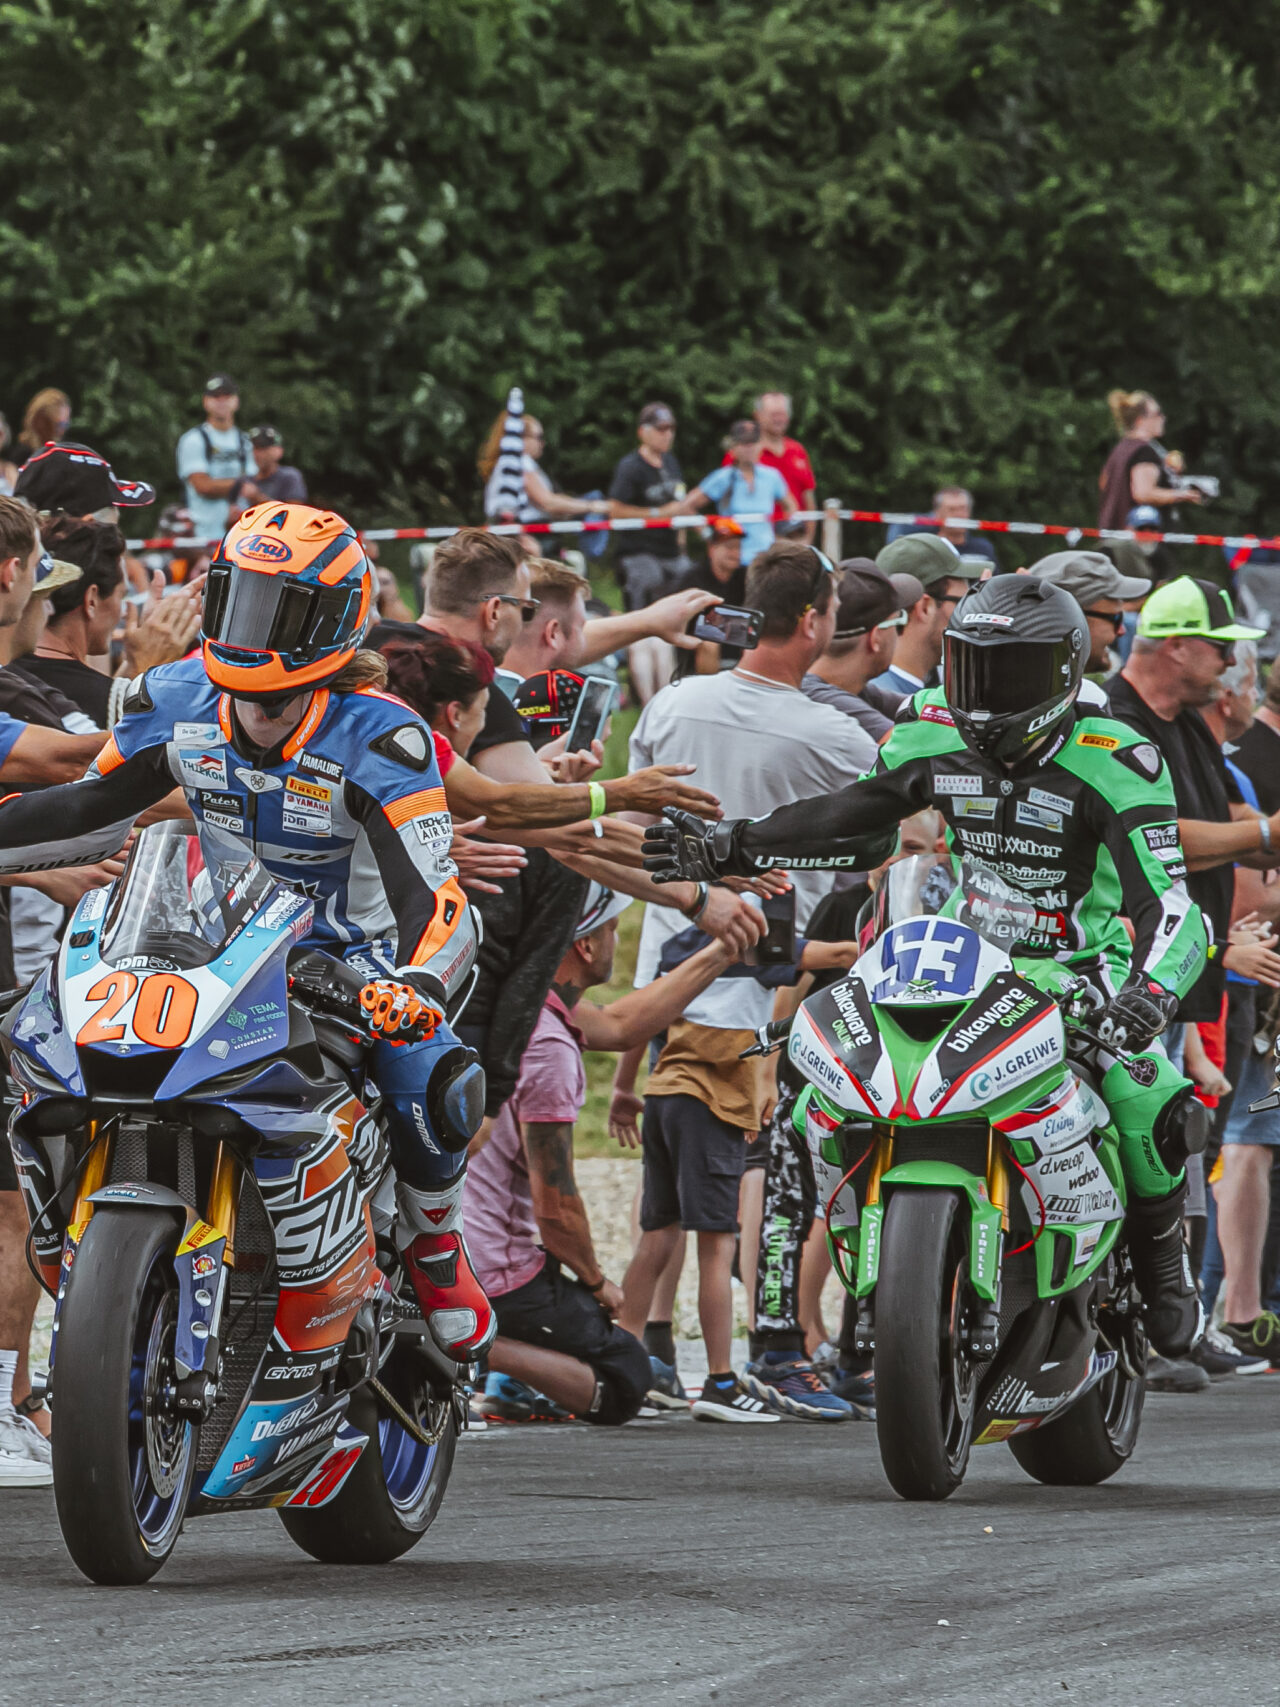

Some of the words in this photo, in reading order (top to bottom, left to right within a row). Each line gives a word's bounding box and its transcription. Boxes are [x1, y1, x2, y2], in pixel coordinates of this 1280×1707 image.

[246, 536, 285, 557] Arai
[301, 753, 343, 778] YAMALUBE
[289, 778, 329, 800] PIRELLI
[296, 797, 330, 813] YAMAHA
[422, 829, 440, 841] AIR
[967, 871, 1068, 911] Kawasaki
[970, 897, 1062, 934] MOTUL
[75, 970, 199, 1049] 20
[248, 1001, 280, 1016] TEMA
[830, 982, 873, 1047] bikeware
[947, 987, 1027, 1053] bikeware
[1000, 996, 1039, 1028] ONLINE
[230, 1026, 274, 1045] CONSTAR
[832, 1018, 856, 1053] ONLINE
[800, 1044, 844, 1091] J.GREIWE
[994, 1036, 1059, 1082] J.GREIWE
[411, 1101, 442, 1156] DAMEN
[1039, 1150, 1085, 1176] d.velop
[1068, 1166, 1099, 1191] wahoo
[186, 1224, 214, 1249] PIRELLI
[978, 1223, 989, 1279] PIRELLI
[264, 1363, 317, 1380] GYTR
[273, 1411, 342, 1465] YAMAHA
[286, 1446, 363, 1507] 20
